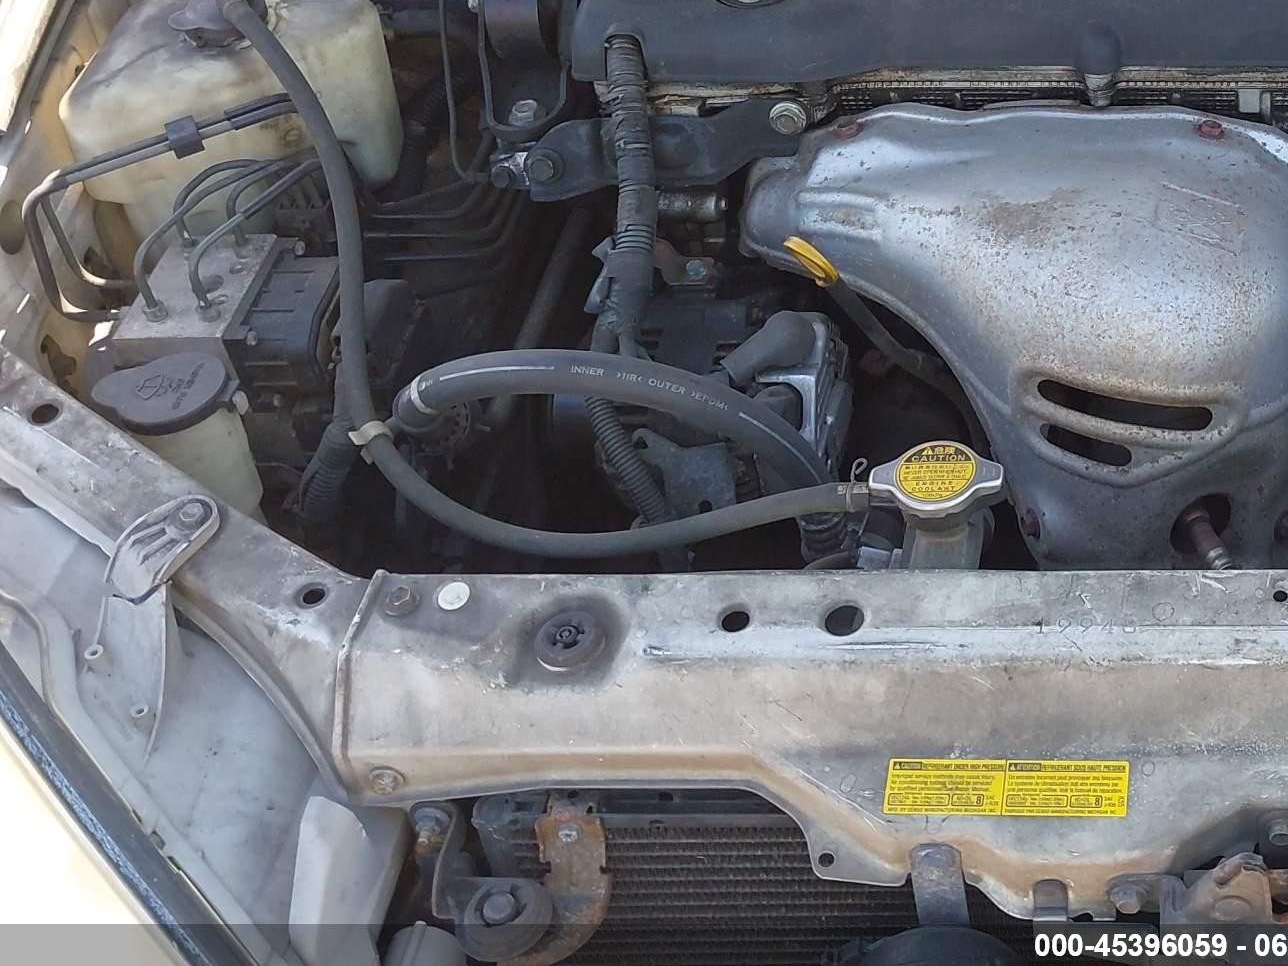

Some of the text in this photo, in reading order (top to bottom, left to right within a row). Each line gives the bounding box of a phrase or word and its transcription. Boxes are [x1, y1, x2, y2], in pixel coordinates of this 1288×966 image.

[570, 365, 604, 377] INNER
[648, 378, 686, 395] OUTER
[911, 454, 966, 462] CAUTION
[975, 796, 981, 805] 8
[1094, 797, 1100, 806] 8
